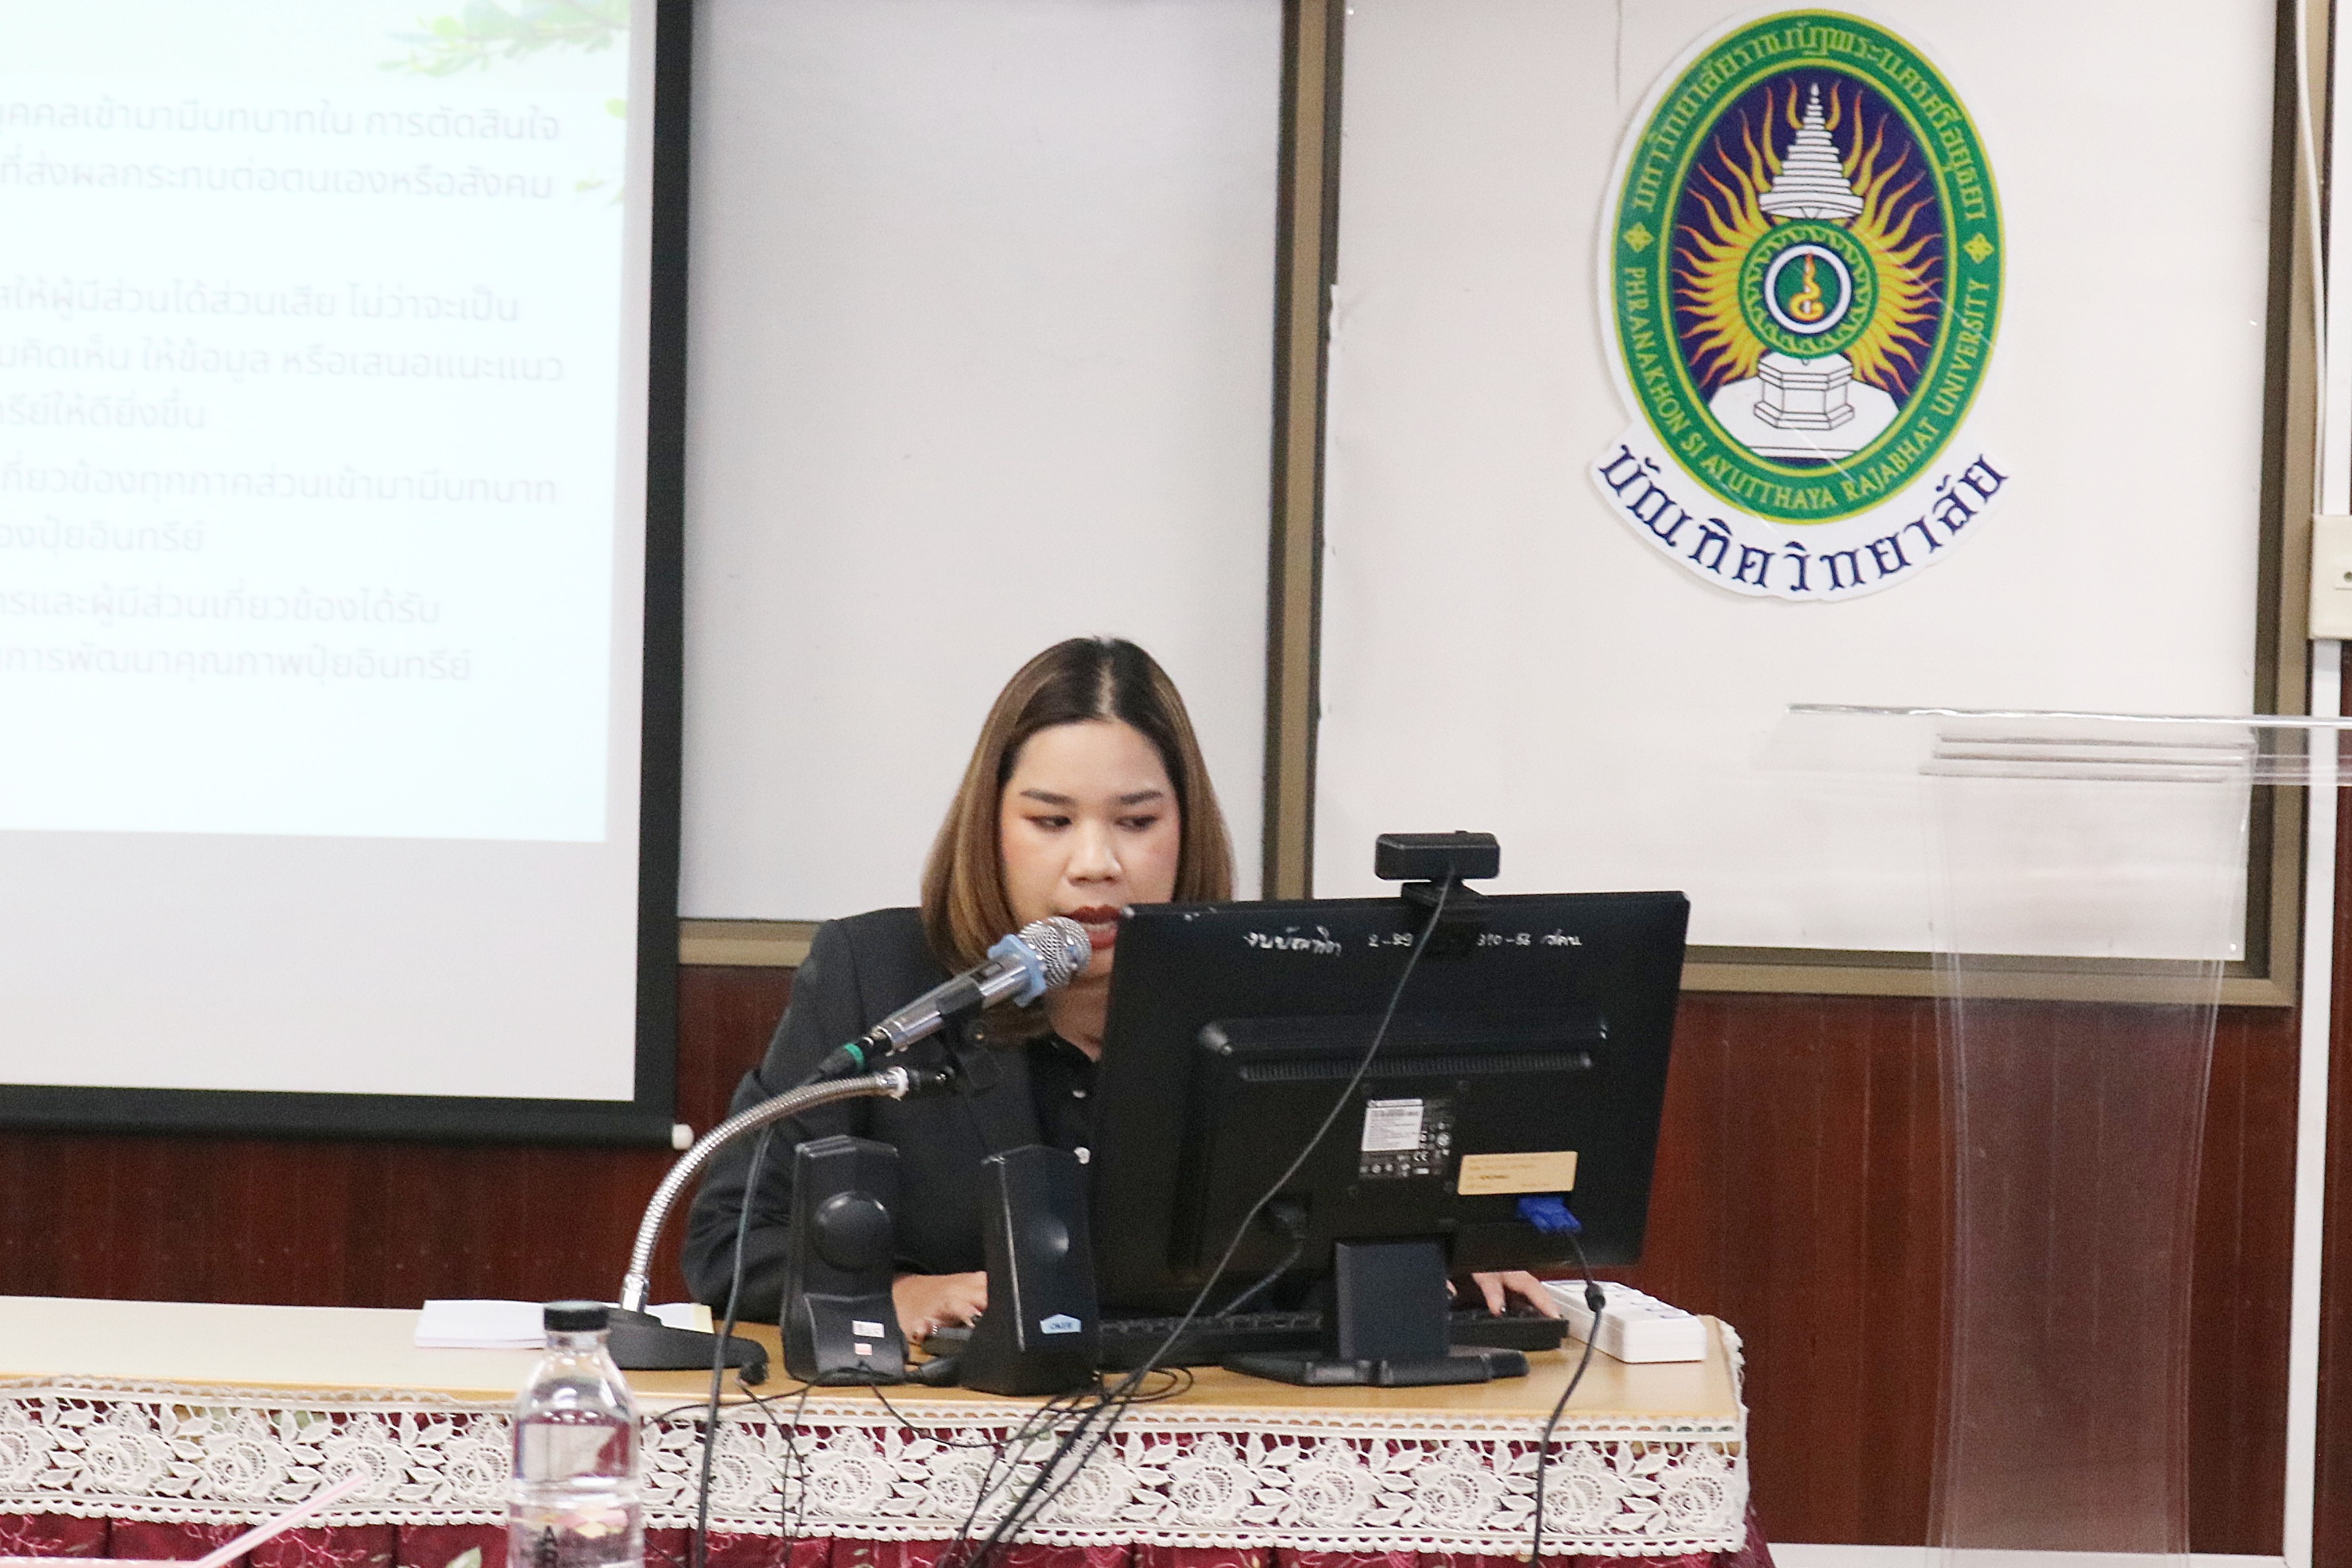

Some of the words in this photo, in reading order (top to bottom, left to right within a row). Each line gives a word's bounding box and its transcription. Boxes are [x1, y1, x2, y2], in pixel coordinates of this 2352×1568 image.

[365, 103, 561, 141] การตัดสินใจ
[348, 281, 519, 323] ไม่ว่าจะเป็น
[141, 335, 270, 384] ให้ข้อมูล
[282, 342, 564, 381] หรือเสนอแนะแนว
[1624, 267, 1692, 436] PHRANAKHON
[1680, 432, 1708, 458] SI
[1700, 454, 1838, 509] AYUTTHAYA
[1840, 416, 1940, 501] RAJABHAT
[1930, 278, 1990, 416] UNIVERSITY
[1598, 443, 2009, 592] บัณฑิตวิทยาลัย
